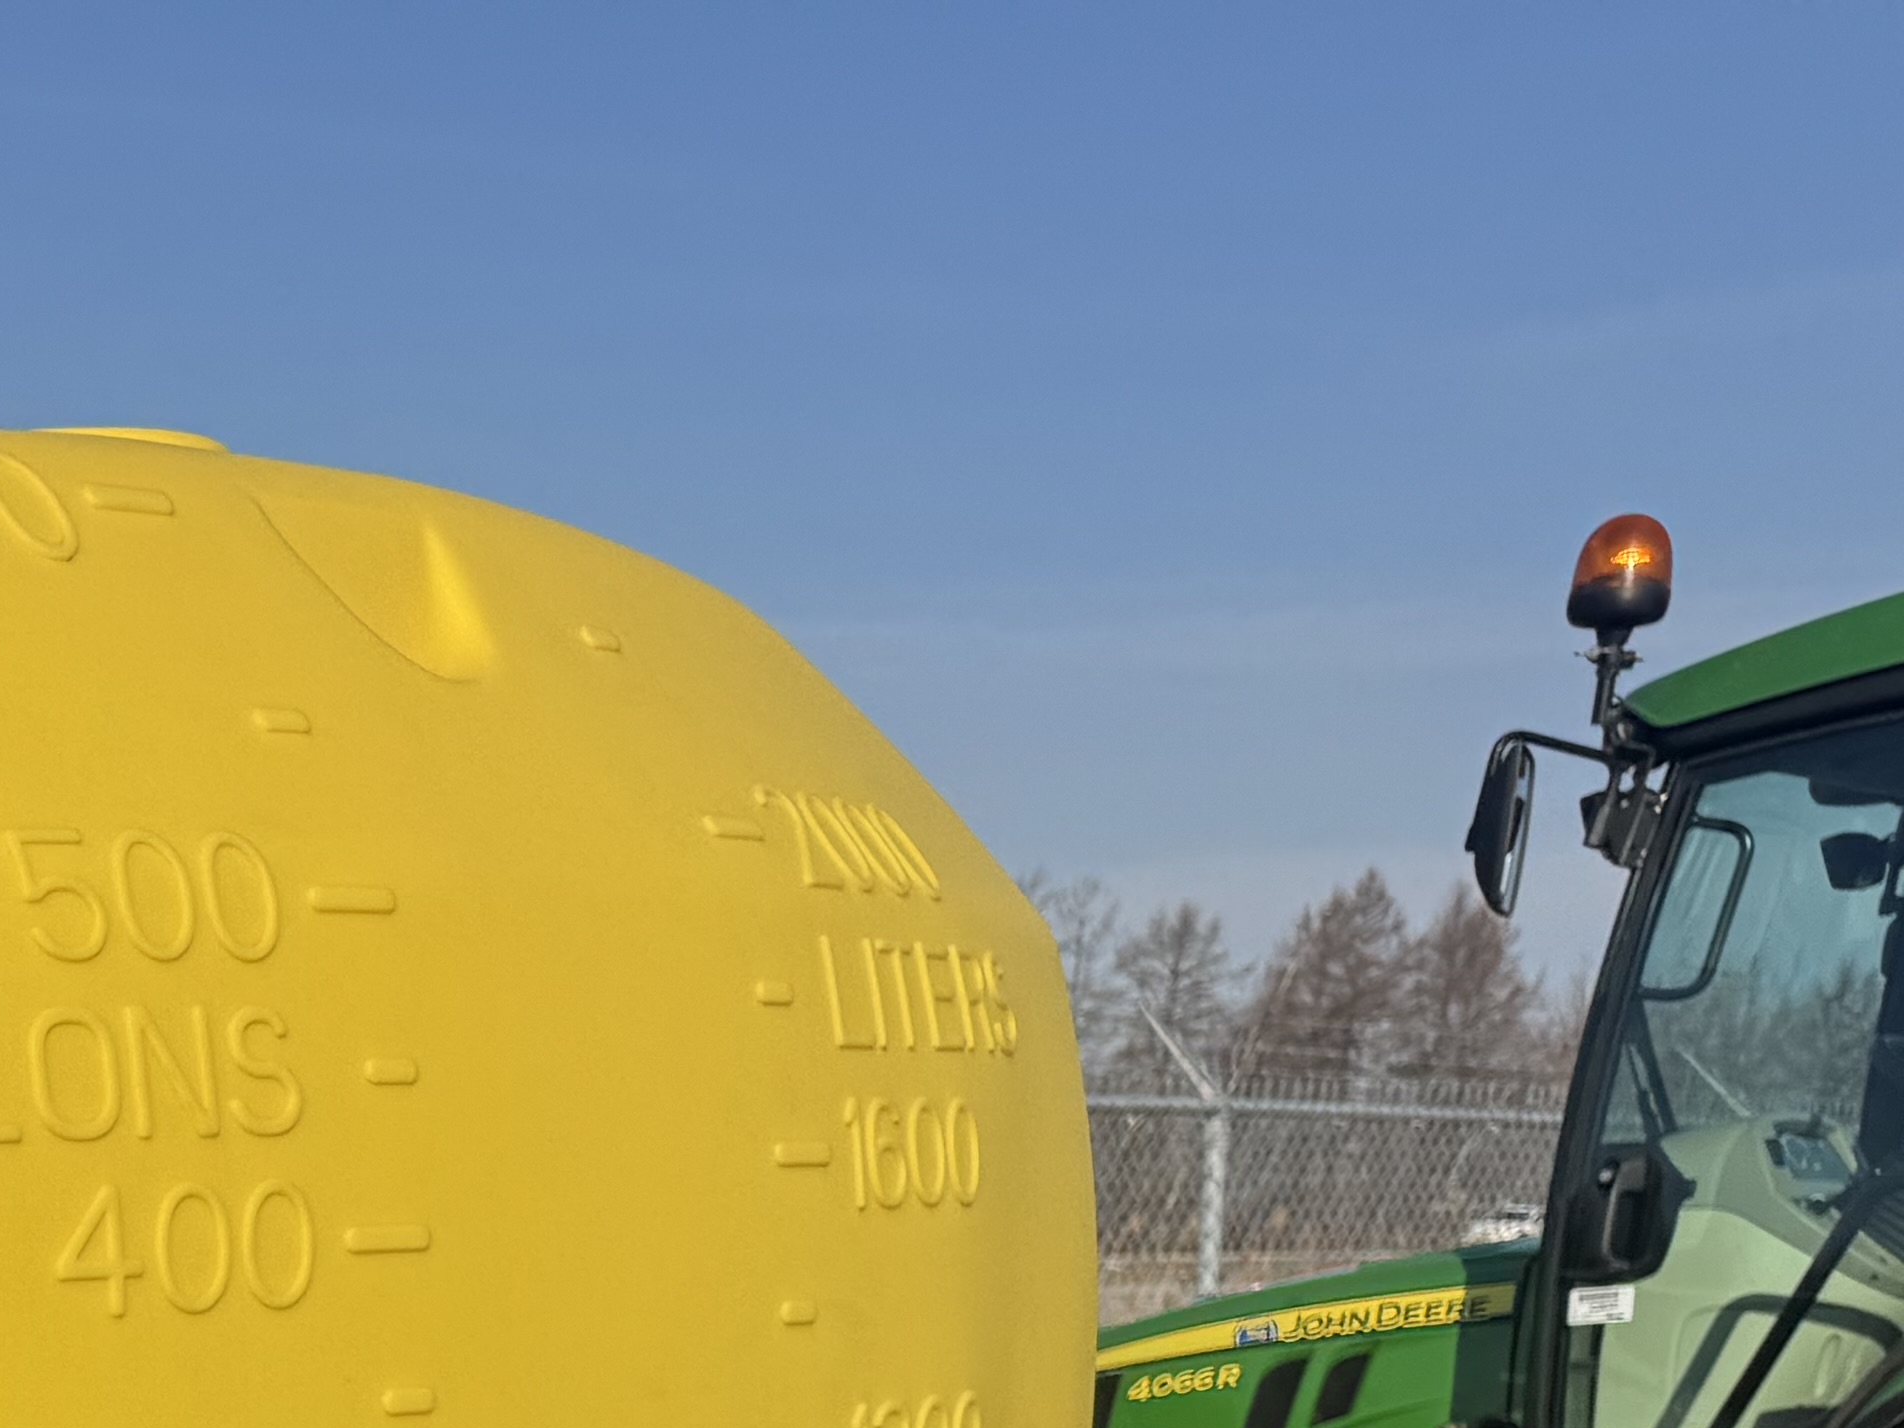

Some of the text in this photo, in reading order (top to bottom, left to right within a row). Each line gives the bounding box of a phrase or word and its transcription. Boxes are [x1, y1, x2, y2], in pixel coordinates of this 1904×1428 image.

[5, 828, 280, 964] 500
[820, 934, 1017, 1058] LITERS
[842, 1096, 980, 1212] 1600
[54, 1179, 315, 1317] 400
[1281, 1295, 1490, 1342] JOHN DEERE
